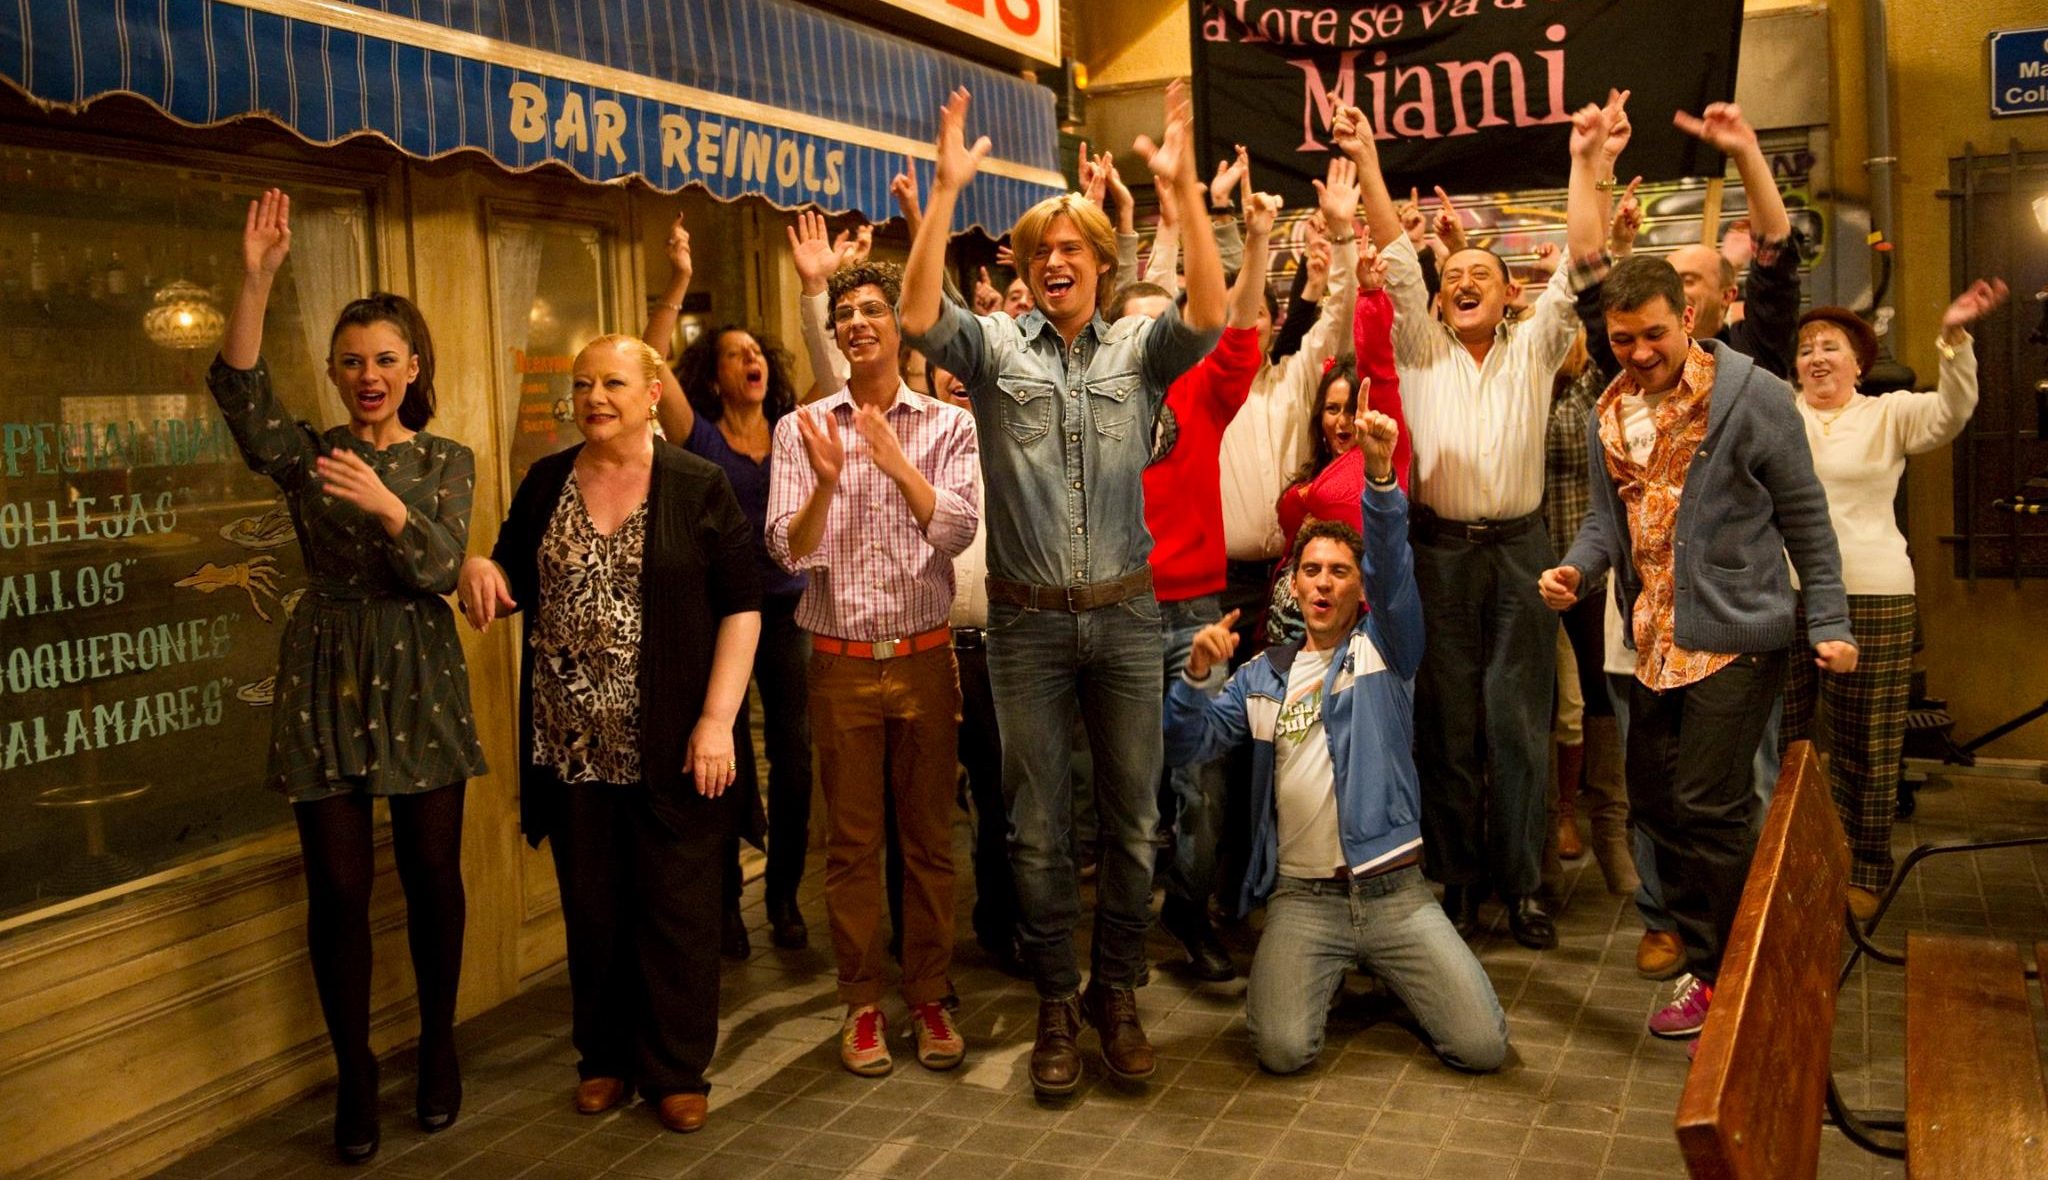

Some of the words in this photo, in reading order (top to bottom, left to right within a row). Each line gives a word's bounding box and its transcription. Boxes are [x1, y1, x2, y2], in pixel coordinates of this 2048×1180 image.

[1233, 0, 1338, 46] Lore
[1349, 4, 1403, 47] se
[509, 82, 627, 163] BAR
[661, 114, 845, 195] REINOLS
[1287, 24, 1573, 152] Miami
